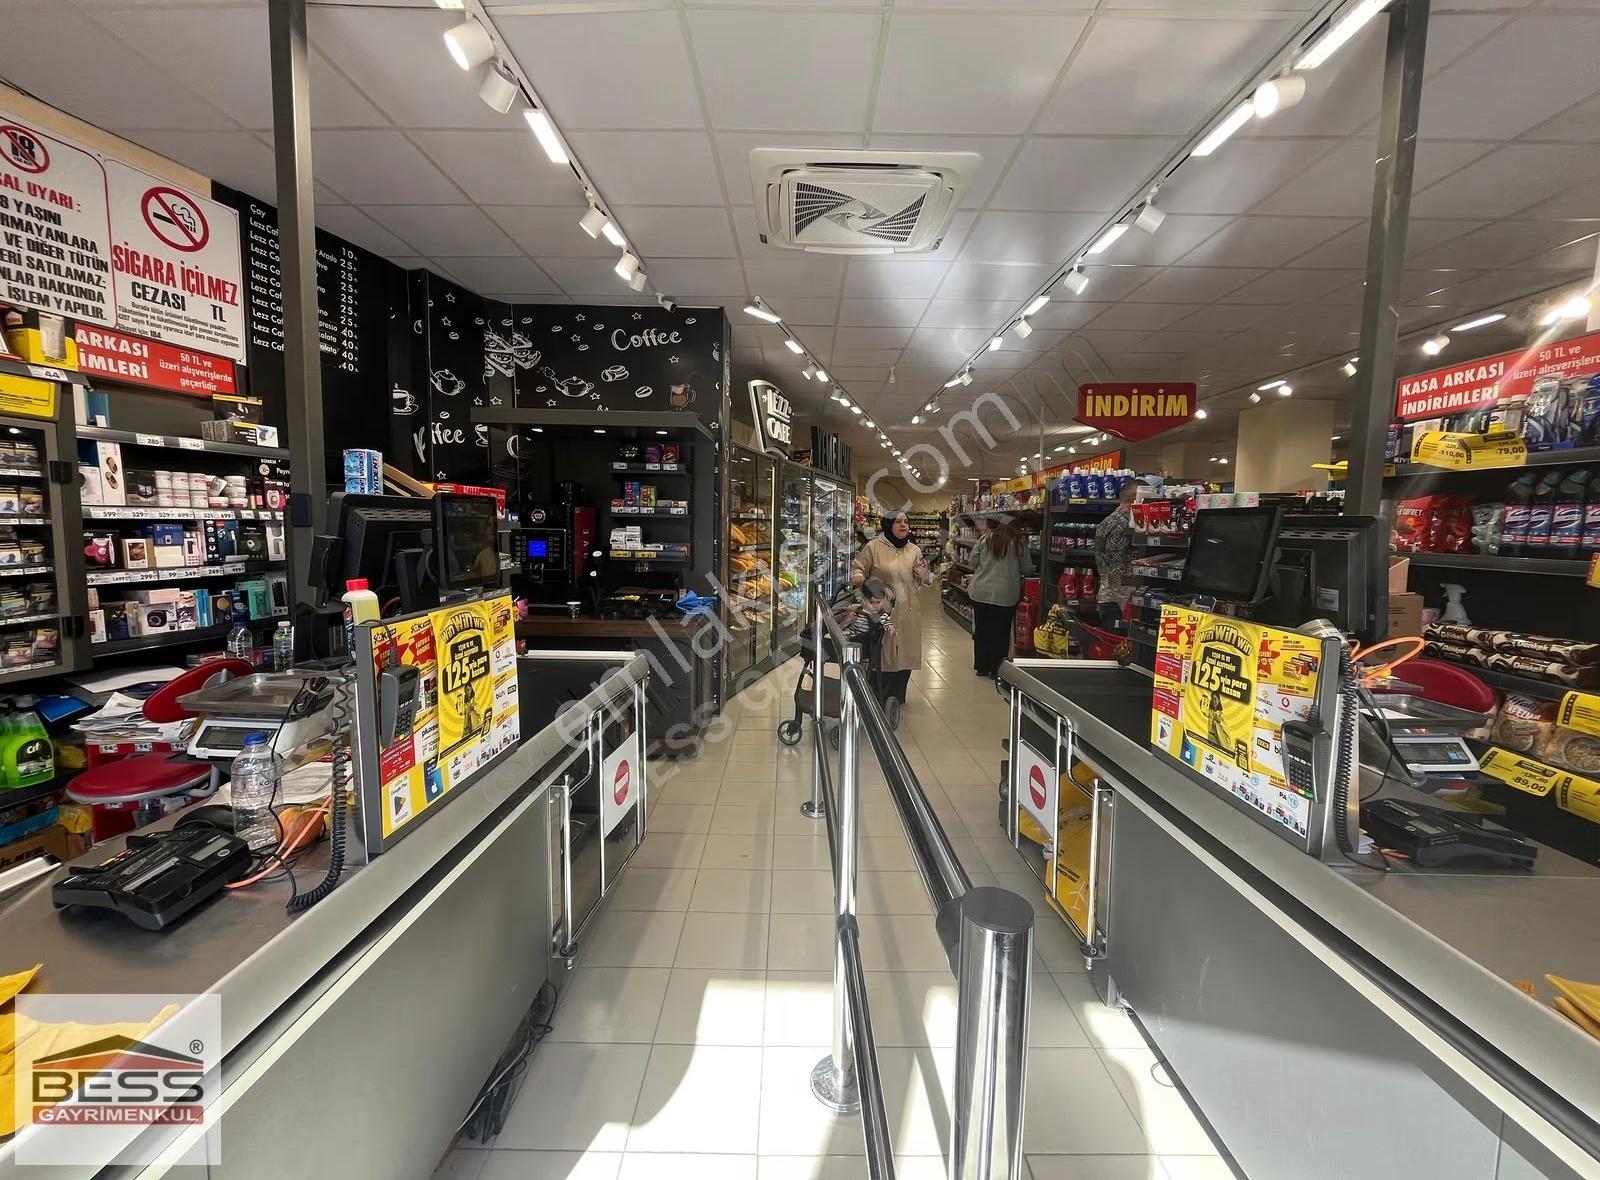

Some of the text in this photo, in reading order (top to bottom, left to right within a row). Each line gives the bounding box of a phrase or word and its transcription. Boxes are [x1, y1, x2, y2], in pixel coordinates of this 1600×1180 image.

[0, 195, 9, 208] 8
[27, 181, 73, 209] UYARI
[250, 204, 266, 218] Çay
[0, 212, 98, 254] RMAYANLARA
[250, 217, 265, 231] Lezz
[250, 230, 267, 244] Lezz
[269, 239, 280, 250] Ca
[0, 248, 22, 266] ERİ
[4, 232, 109, 273] VE DİĞER TÜTÜN
[251, 243, 267, 257] Lezz
[270, 251, 280, 261] Ca
[112, 242, 239, 307] SİGARA İÇİLMEZ
[251, 257, 268, 270] Lezz
[270, 265, 280, 275] Ca
[0, 266, 105, 304] NLAR HAKKINDA
[250, 281, 267, 294] Lezz
[251, 270, 268, 283] Lezz
[270, 277, 280, 288] Ca
[7, 282, 50, 308] İŞLEM
[131, 281, 227, 322] CEZASI TL
[252, 295, 269, 307] Lezz
[252, 308, 269, 320] Lezz
[253, 321, 270, 333] Lezz
[75, 328, 149, 358] ARKASI
[253, 335, 269, 348] Lezz
[271, 341, 284, 351] Caf
[611, 328, 682, 350] Coffee
[79, 348, 149, 379] İMLERİ
[180, 353, 212, 368] 50 TL ve
[1540, 345, 1581, 361] 50 TL ve
[159, 359, 233, 383] üzeri alışverişlerde
[1402, 379, 1438, 397] KASA
[1442, 362, 1504, 388] ARKASI
[1513, 366, 1536, 379] üzeri
[180, 377, 217, 391] geçerlidir
[1086, 388, 1188, 417] İNDİRİM
[1402, 382, 1500, 416] İNDİRİMLERİ
[766, 417, 792, 444] CAFE
[443, 656, 470, 692] 125
[1194, 660, 1221, 691] 125
[26, 741, 42, 755] Cif
